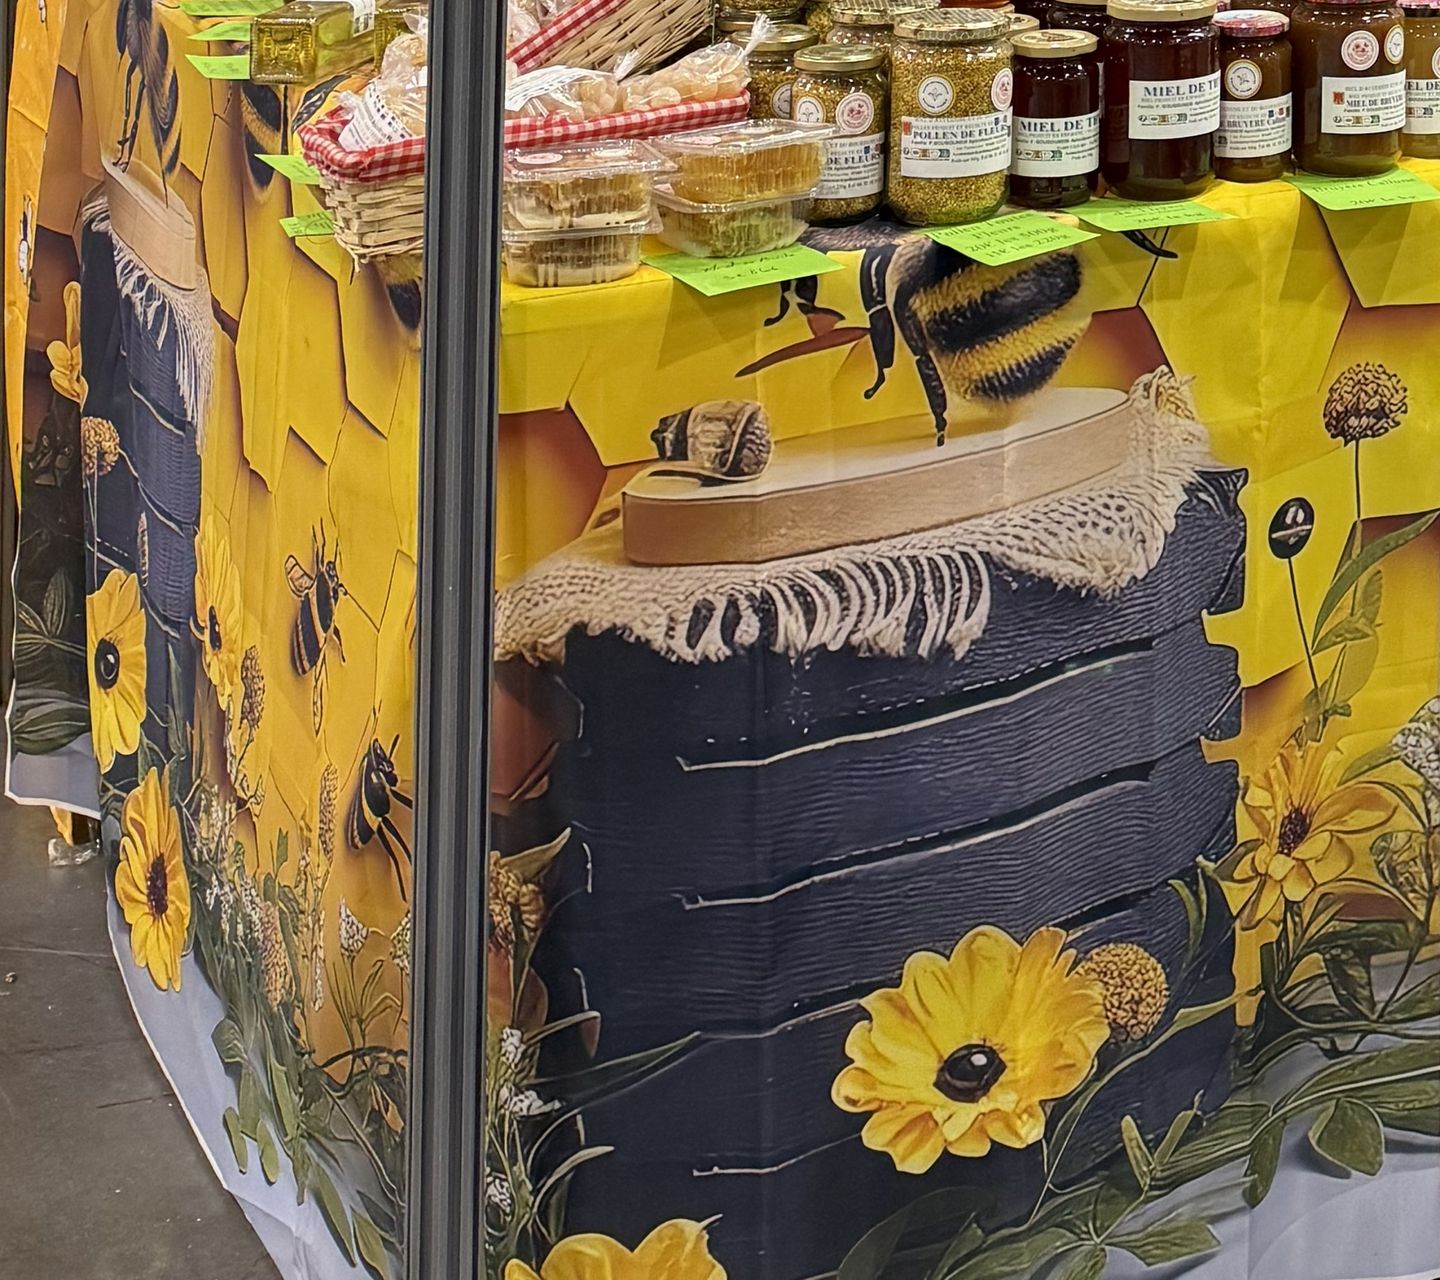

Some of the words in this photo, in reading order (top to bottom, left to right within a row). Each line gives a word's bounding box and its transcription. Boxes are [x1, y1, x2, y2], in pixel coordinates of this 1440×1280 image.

[1143, 85, 1186, 97] MIEL
[1189, 83, 1206, 94] DE
[1020, 120, 1054, 132] MIEL
[1064, 119, 1082, 130] DE
[912, 127, 958, 140] POLLEN
[961, 126, 976, 138] DE
[826, 156, 842, 165] DE
